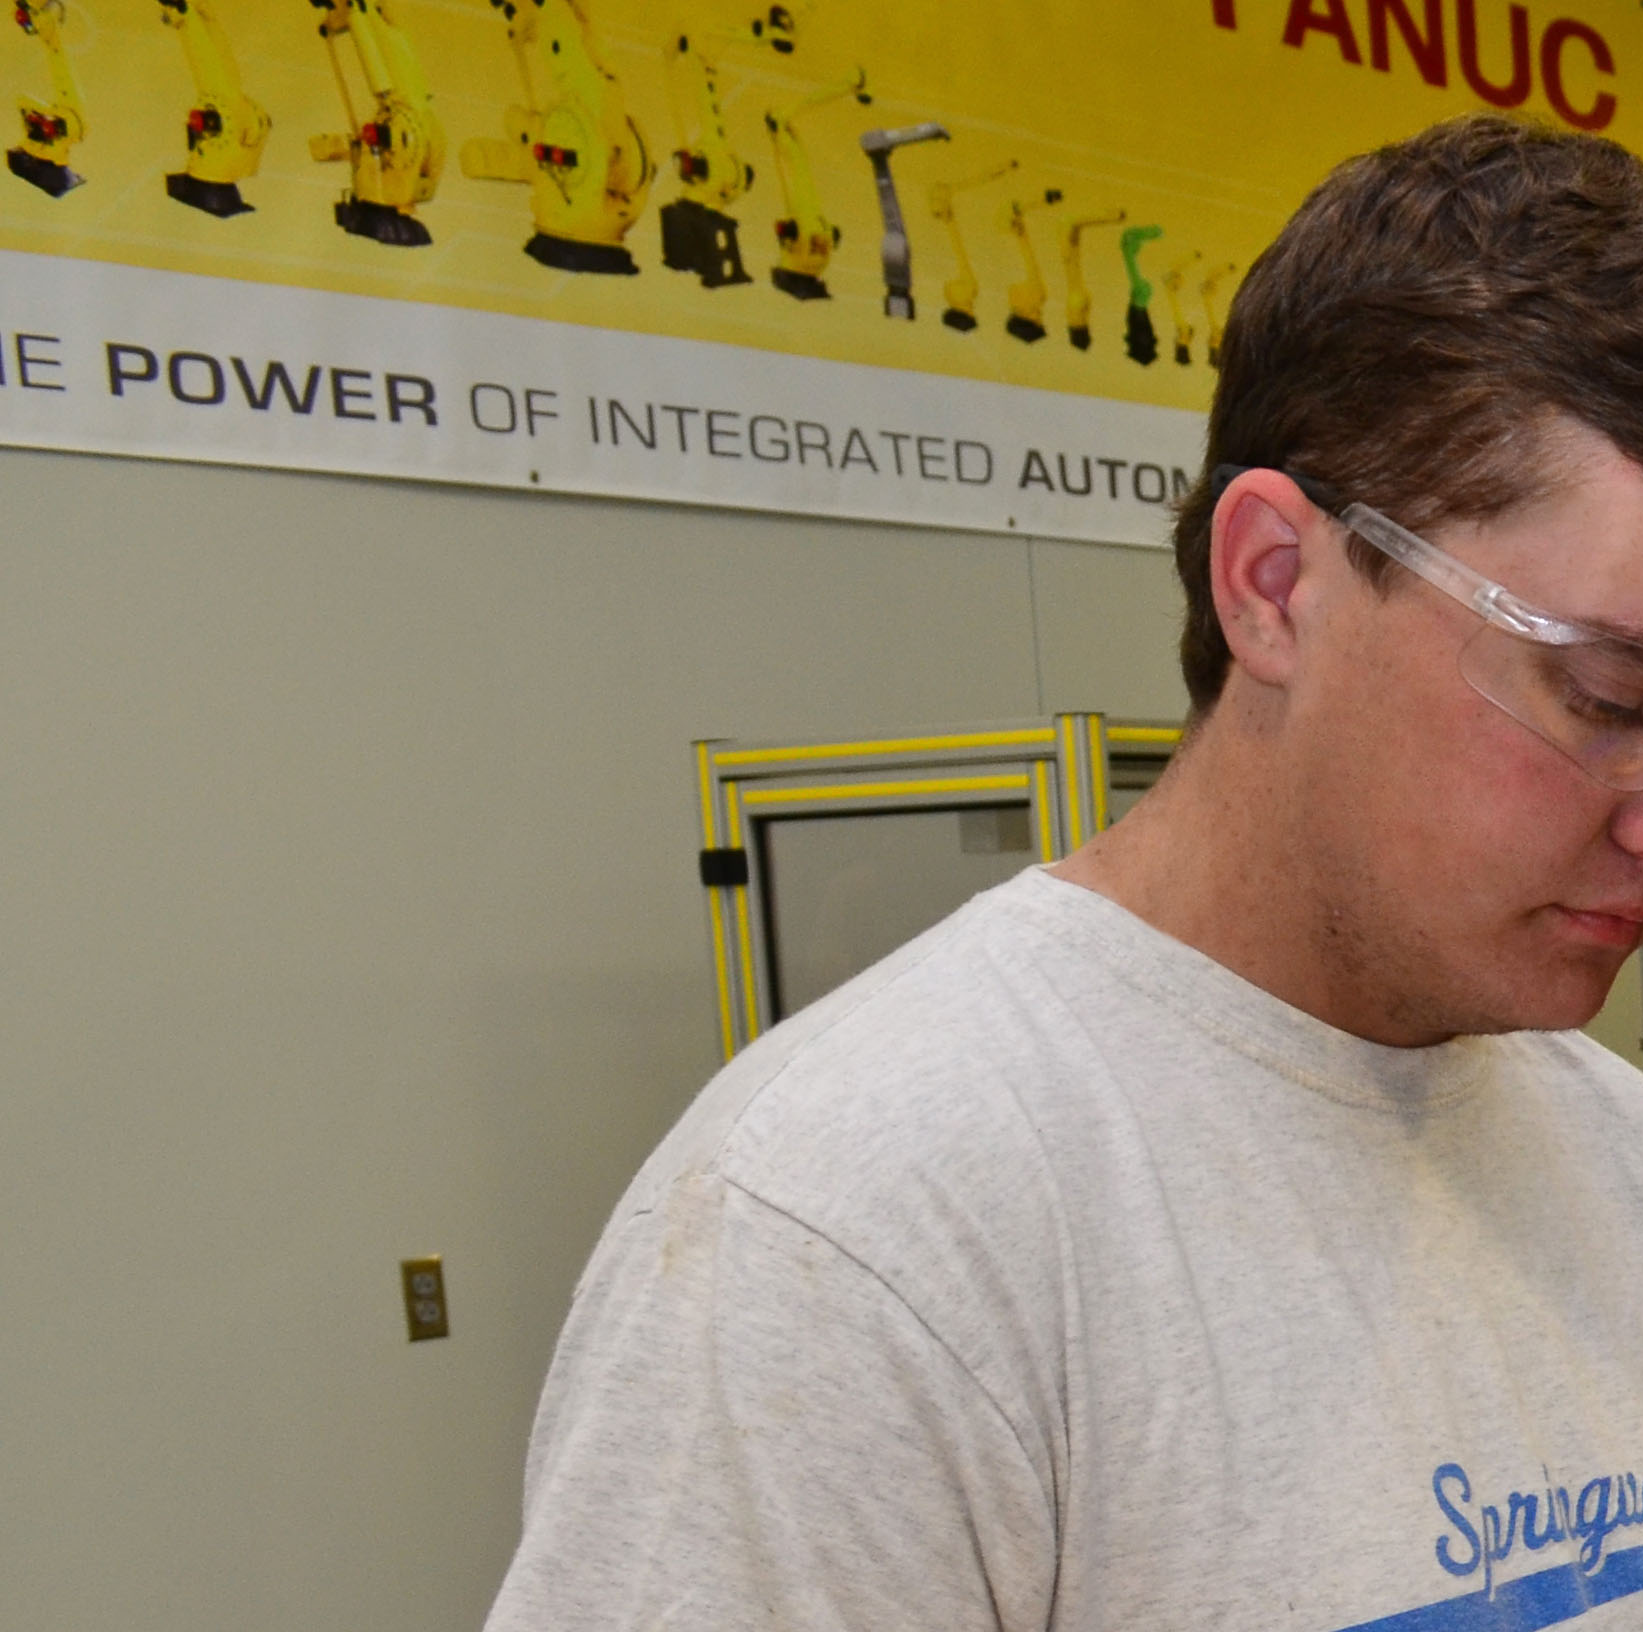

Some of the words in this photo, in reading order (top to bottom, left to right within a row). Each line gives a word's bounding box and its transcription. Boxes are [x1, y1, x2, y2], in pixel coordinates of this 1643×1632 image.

[106, 342, 439, 426] POWER
[471, 382, 559, 437] OF
[587, 397, 993, 484] INTEGRATED
